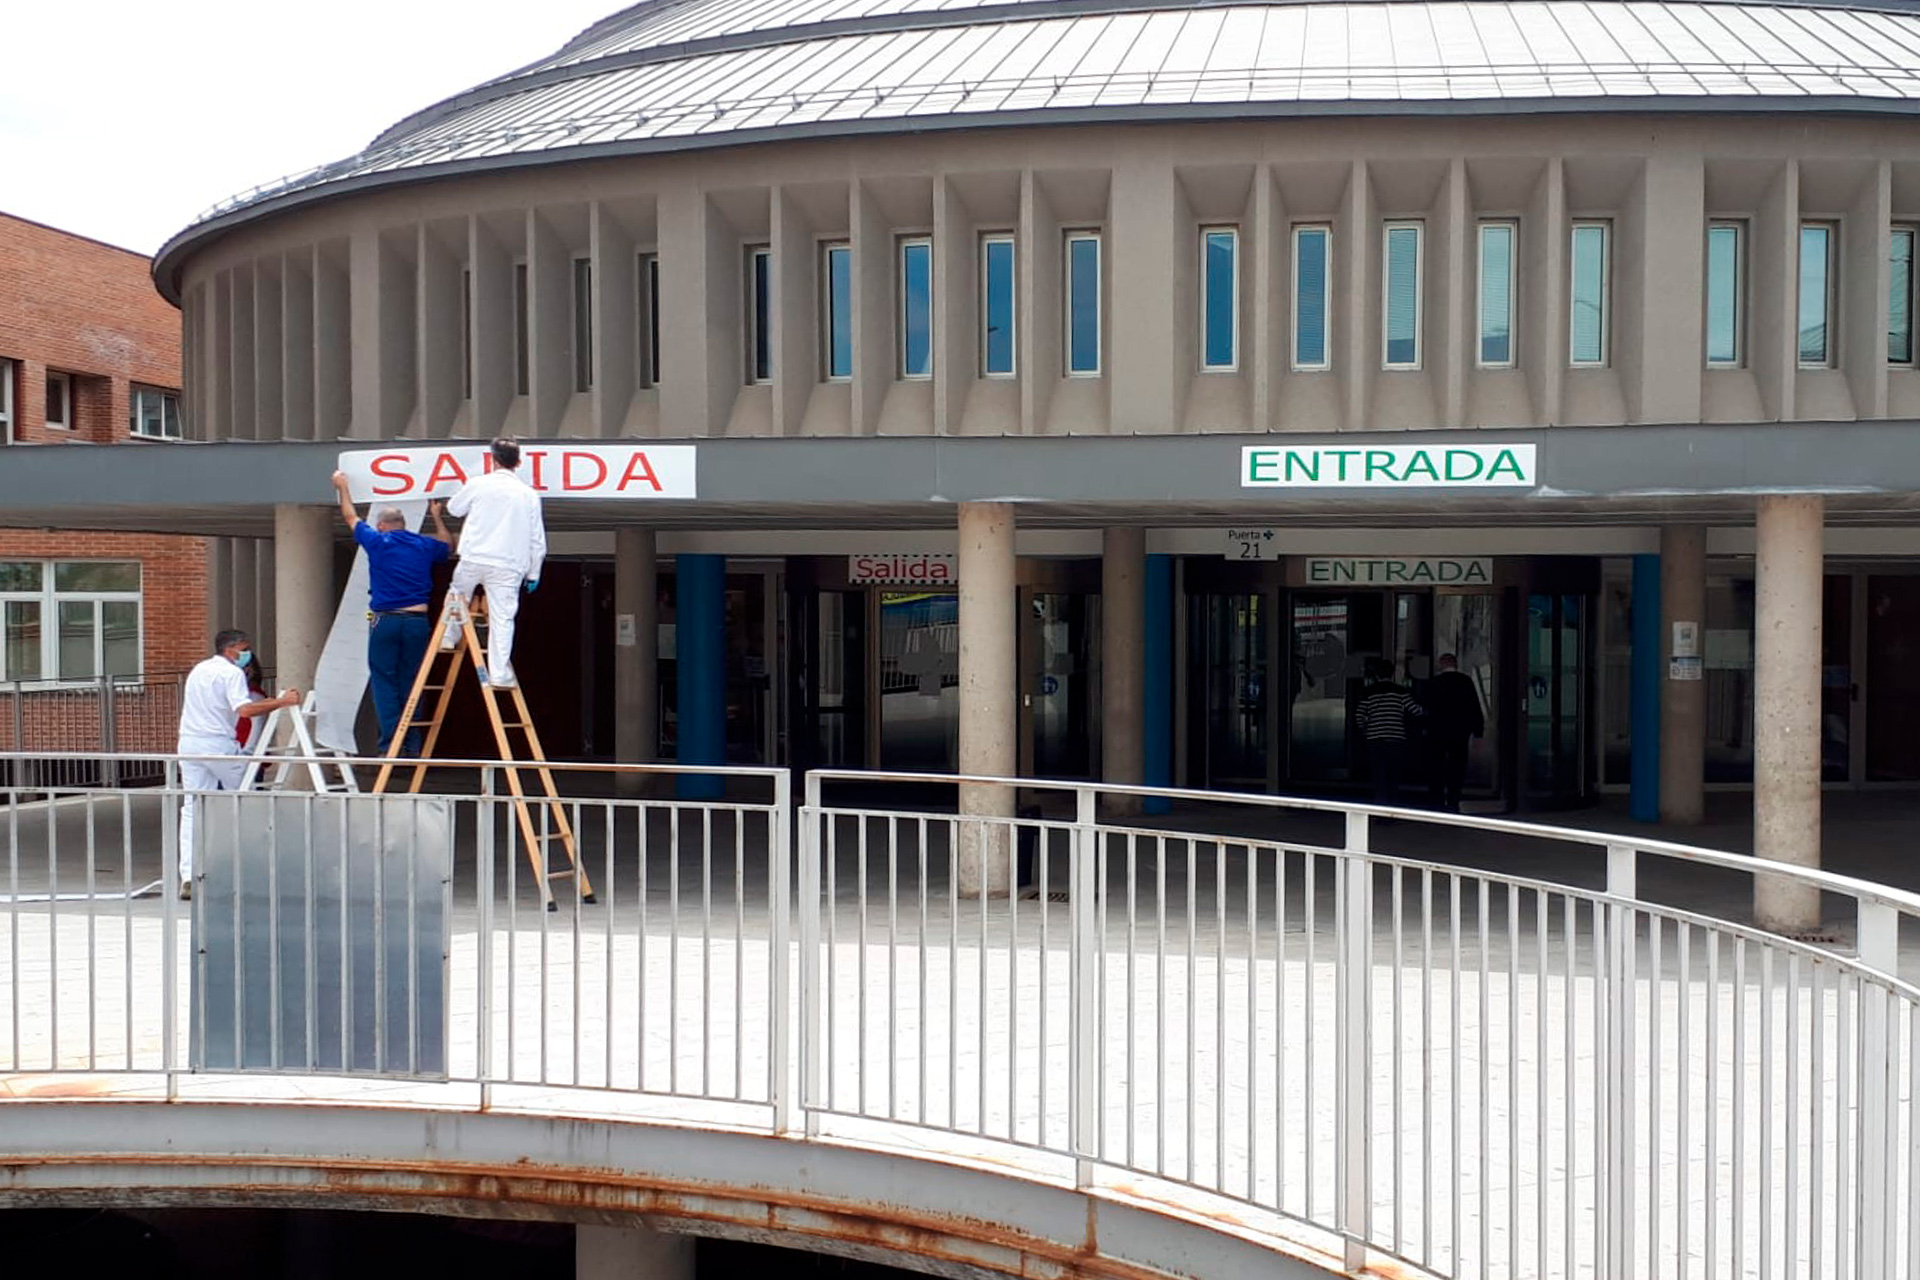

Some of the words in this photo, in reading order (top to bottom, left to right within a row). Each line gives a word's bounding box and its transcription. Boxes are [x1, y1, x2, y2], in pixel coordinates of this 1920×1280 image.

[370, 452, 663, 495] SAIDA
[1249, 449, 1525, 481] ENTRADA
[1228, 530, 1260, 541] Puerta
[1241, 542, 1261, 558] 21
[857, 558, 949, 578] Salida
[1310, 561, 1487, 582] ENTRADA
